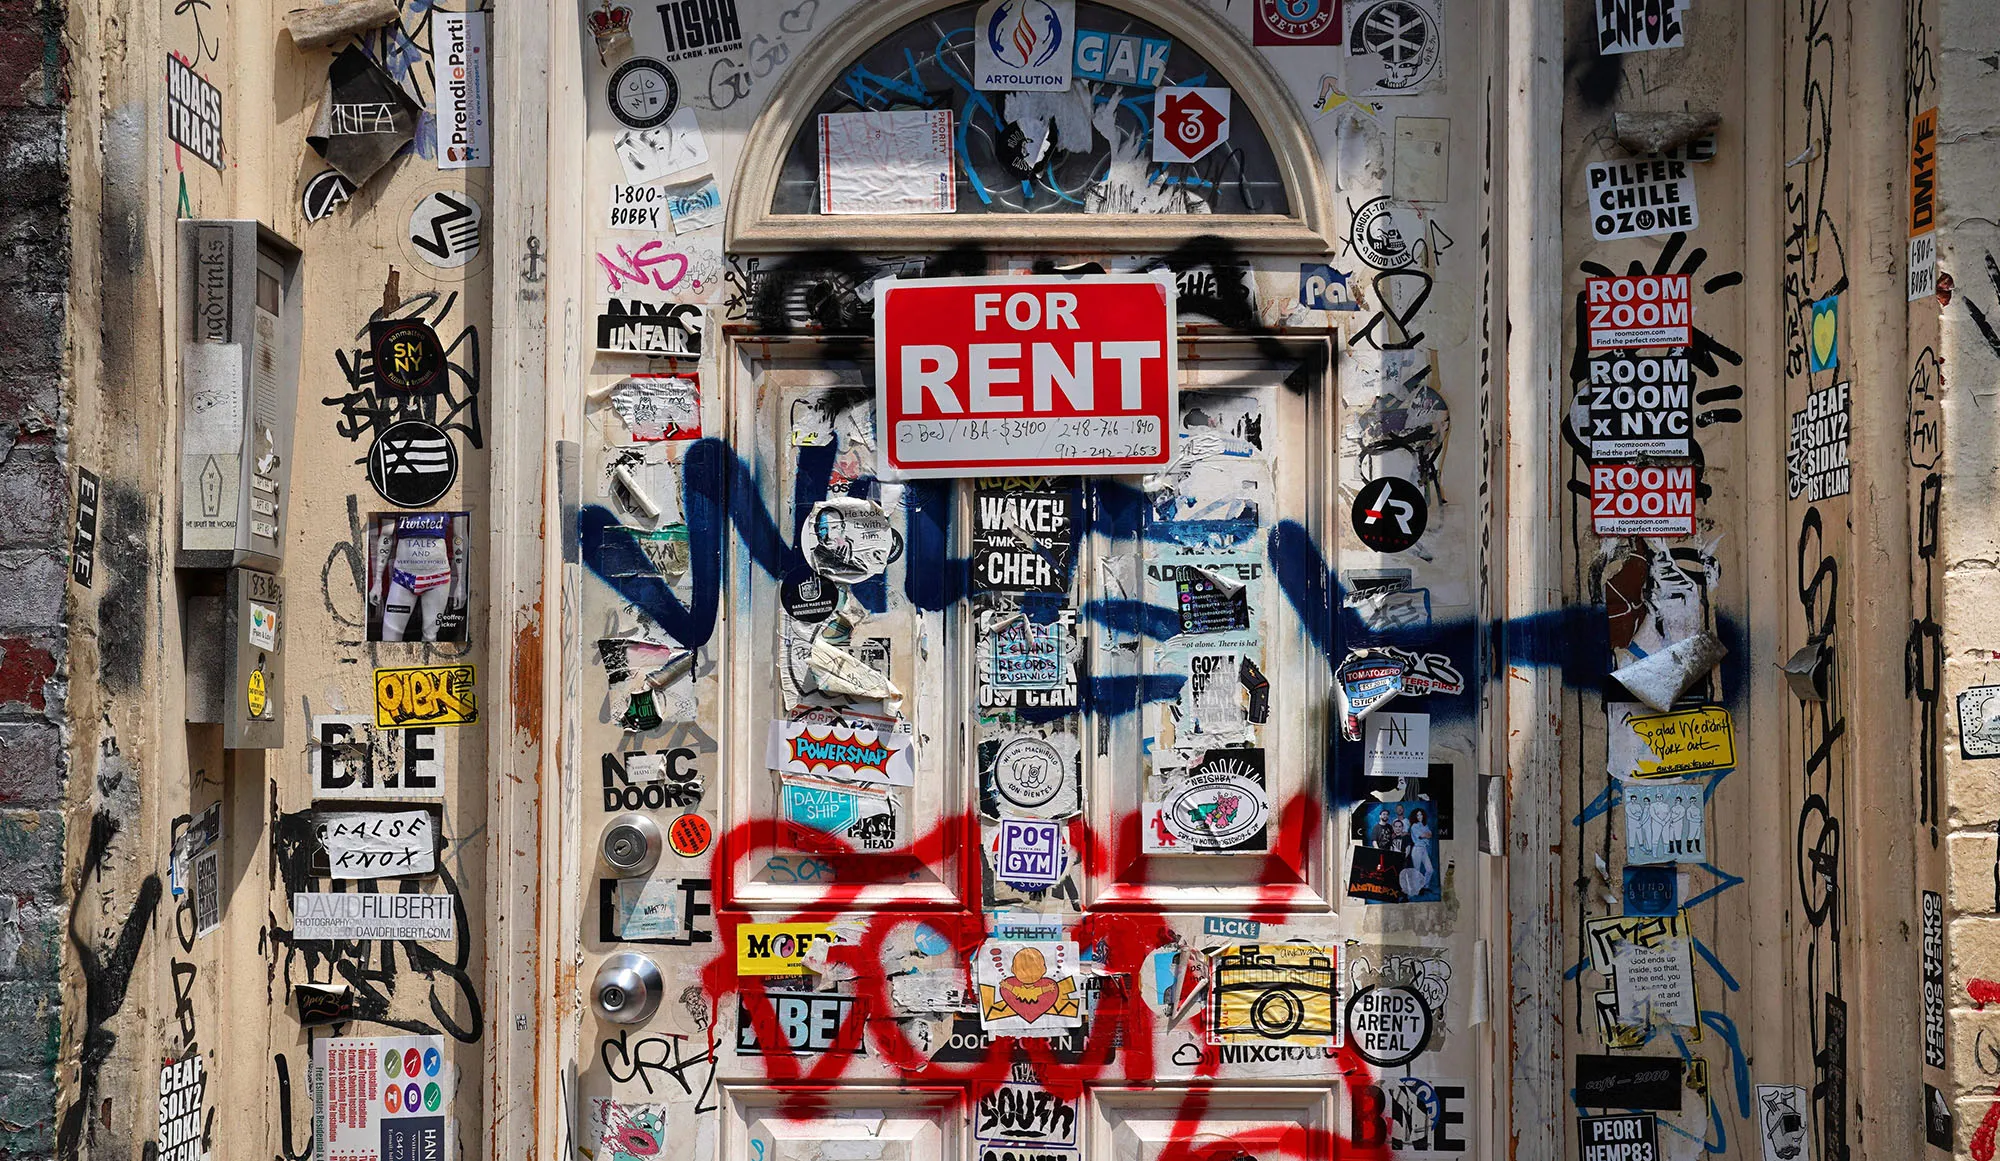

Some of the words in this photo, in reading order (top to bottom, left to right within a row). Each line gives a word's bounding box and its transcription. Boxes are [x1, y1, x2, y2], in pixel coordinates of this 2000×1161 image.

[1269, 12, 1329, 34] BETTER
[1075, 35, 1167, 86] GAK
[447, 19, 467, 145] PrendieParti
[985, 74, 1063, 85] ARTOLUTION
[169, 97, 222, 167] TRACE
[939, 111, 947, 154] PRIORITY
[1591, 160, 1687, 189] PILFER
[615, 184, 663, 204] 1-800-
[1600, 182, 1679, 211] CHILE
[611, 207, 659, 228] BOBBY
[1367, 252, 1389, 268] GOOD
[1391, 248, 1412, 267] LUCK
[1590, 277, 1688, 302] ROOM
[1911, 264, 1934, 297] BOBBY
[974, 292, 1080, 331] FOR
[1590, 303, 1688, 328] ZOOM
[609, 322, 689, 353] UNFAIR
[1614, 329, 1666, 337] roomzoom.com
[1624, 336, 1648, 345] perfect
[1649, 335, 1685, 343] roommate.
[394, 342, 423, 358] SM
[395, 356, 423, 373] NY
[1590, 359, 1688, 384] ROOM
[901, 340, 1160, 415] RENT
[1590, 385, 1688, 410] ZOOM
[1808, 384, 1849, 422] CEAF
[918, 421, 944, 441] Bed
[1593, 418, 1612, 436] x
[1621, 412, 1689, 436] NYC
[1808, 411, 1849, 451] SOLY2
[1612, 448, 1623, 456] the
[1649, 447, 1685, 455] roommate.
[1808, 440, 1849, 476] SIDKA
[1594, 467, 1693, 491] ROOM
[1808, 475, 1824, 502] OST
[1825, 467, 1849, 498] CLAN
[860, 509, 881, 517] took
[1594, 491, 1692, 516] ZOOM
[217, 520, 237, 528] WORLD
[399, 516, 443, 529] Twisted
[862, 520, 882, 529] with
[980, 497, 1051, 533] WAKE
[861, 531, 882, 540] him.
[1627, 525, 1651, 534] perfect
[1652, 524, 1689, 532] roommate.
[407, 539, 436, 548] TALES
[987, 552, 1051, 586] CHER
[435, 620, 457, 628] Dicker
[437, 613, 464, 621] Geoffrey
[999, 644, 1054, 655] ISLAND
[1218, 640, 1238, 648] There
[1000, 660, 1057, 670] RECORDS
[1347, 668, 1400, 681] TOMATOZERO
[1000, 672, 1056, 683] BUSHWICK
[1432, 682, 1460, 691] FIRST
[1025, 685, 1077, 707] CLAN
[1655, 722, 1676, 742] glad
[796, 737, 887, 765] POWERSNAP
[1012, 748, 1020, 756] UN
[1025, 747, 1058, 765] MACHIRULO
[604, 783, 700, 812] DOORS
[794, 791, 847, 805] DAZZLE
[1008, 783, 1020, 794] CON
[333, 817, 426, 838] FALSE
[863, 840, 894, 849] HEAD
[335, 847, 418, 869] KNOX
[1008, 853, 1050, 873] GYM
[295, 918, 349, 926] PHOTOGRAPHY
[1209, 919, 1249, 936] LICK
[356, 927, 450, 938] DAVIDFILIBERTI.COM
[1281, 945, 1326, 957] awkward
[1667, 974, 1681, 982] you
[1364, 995, 1415, 1013] BIRDS
[1357, 1015, 1420, 1032] AREN'T
[1366, 1034, 1411, 1051] REAL
[160, 1064, 201, 1096] CEAF
[316, 1067, 324, 1081] Free
[1634, 1070, 1669, 1084] 2000
[160, 1083, 201, 1125] SOLY2
[315, 1082, 324, 1114] Estimates
[348, 1098, 356, 1128] Installation
[358, 1098, 366, 1128] Installation
[159, 1113, 200, 1147] SIDKA
[316, 1115, 324, 1152] Residential
[329, 1112, 337, 1142] Installation
[396, 1131, 404, 1160] (347)
[1585, 1142, 1653, 1161] HEMP83
